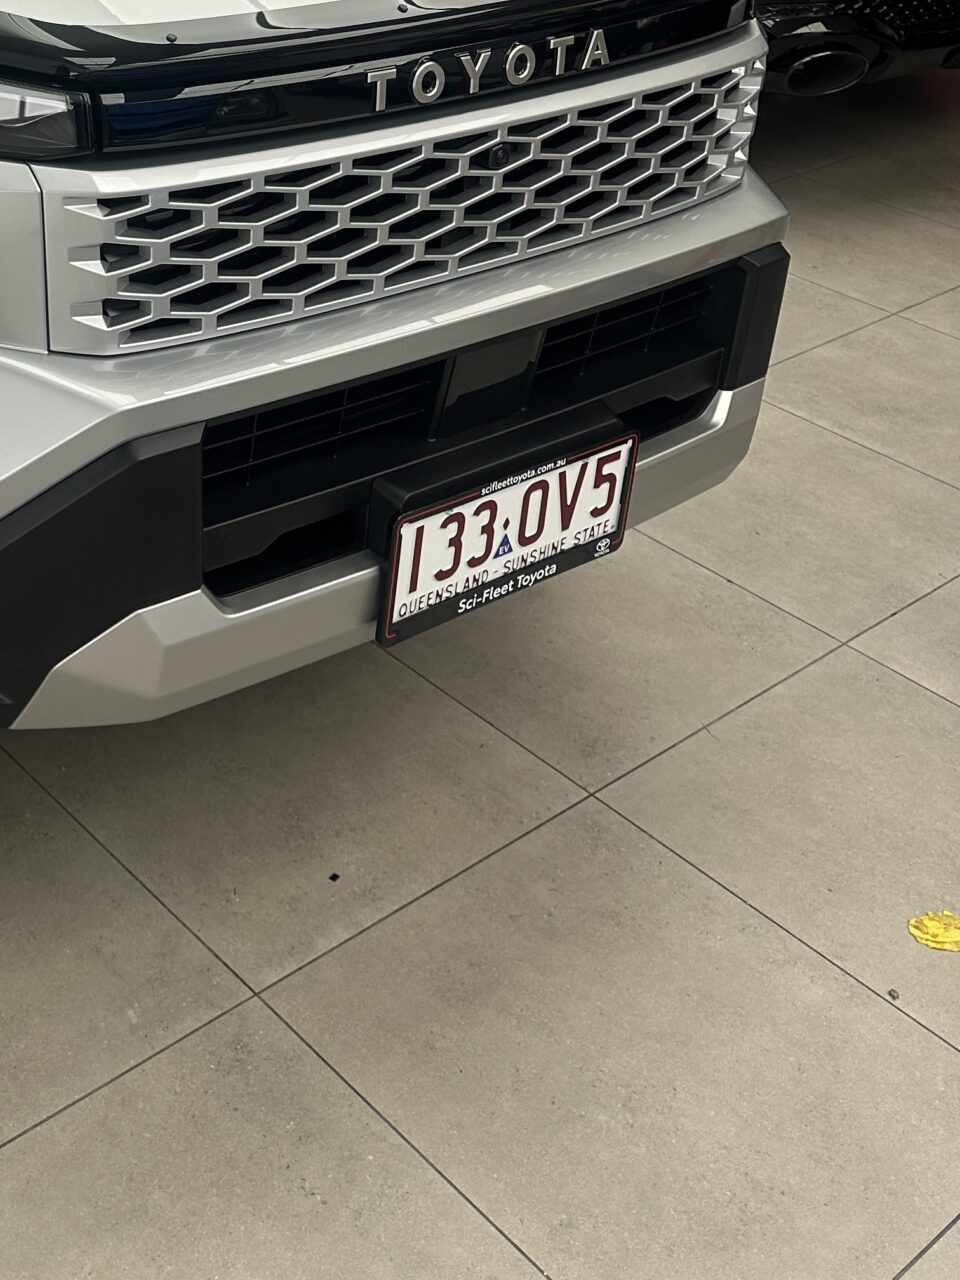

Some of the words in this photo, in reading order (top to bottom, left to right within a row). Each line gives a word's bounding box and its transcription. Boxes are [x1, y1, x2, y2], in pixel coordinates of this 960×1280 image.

[366, 28, 610, 112] TOYOTA
[481, 458, 567, 496] scifleettoyota.com.au
[498, 545, 510, 556] EV
[398, 569, 489, 618] QUEENSLAND
[503, 537, 567, 575] SUNSHINE
[458, 580, 514, 614] Sci-Fleet
[517, 564, 557, 589] Toyota
